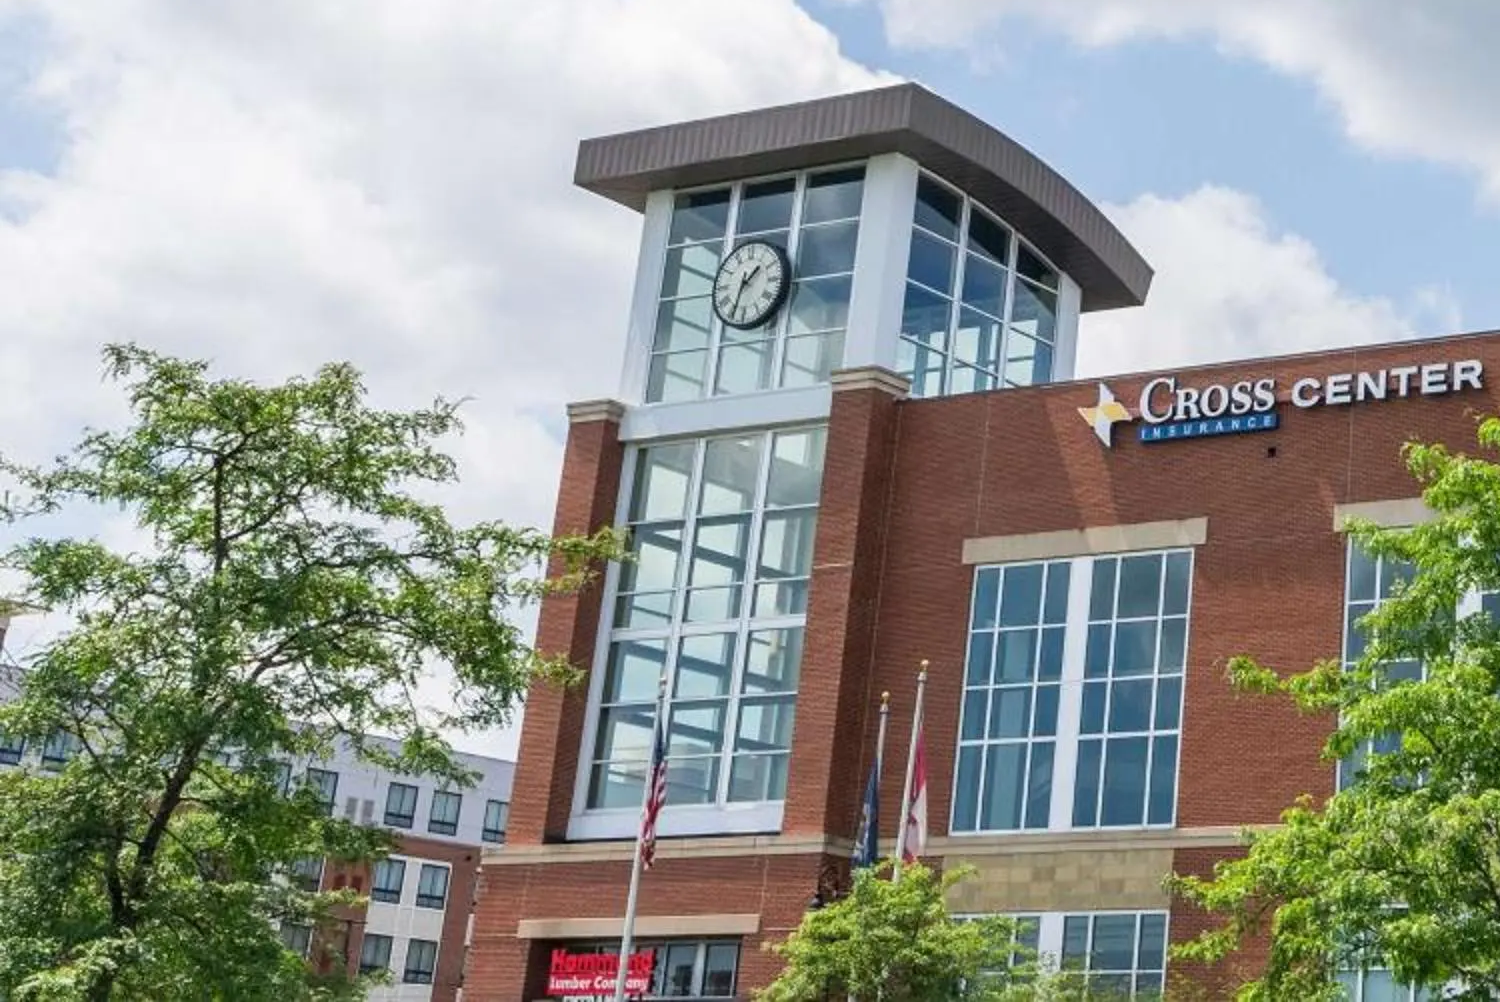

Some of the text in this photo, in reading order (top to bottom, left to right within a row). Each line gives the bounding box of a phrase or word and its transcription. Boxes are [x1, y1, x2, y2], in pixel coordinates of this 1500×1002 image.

[1140, 359, 1483, 423] CROSS CENTER
[1141, 415, 1273, 439] INSURANCE
[551, 949, 653, 973] Hammnd
[549, 976, 649, 991] Lumber Comany
